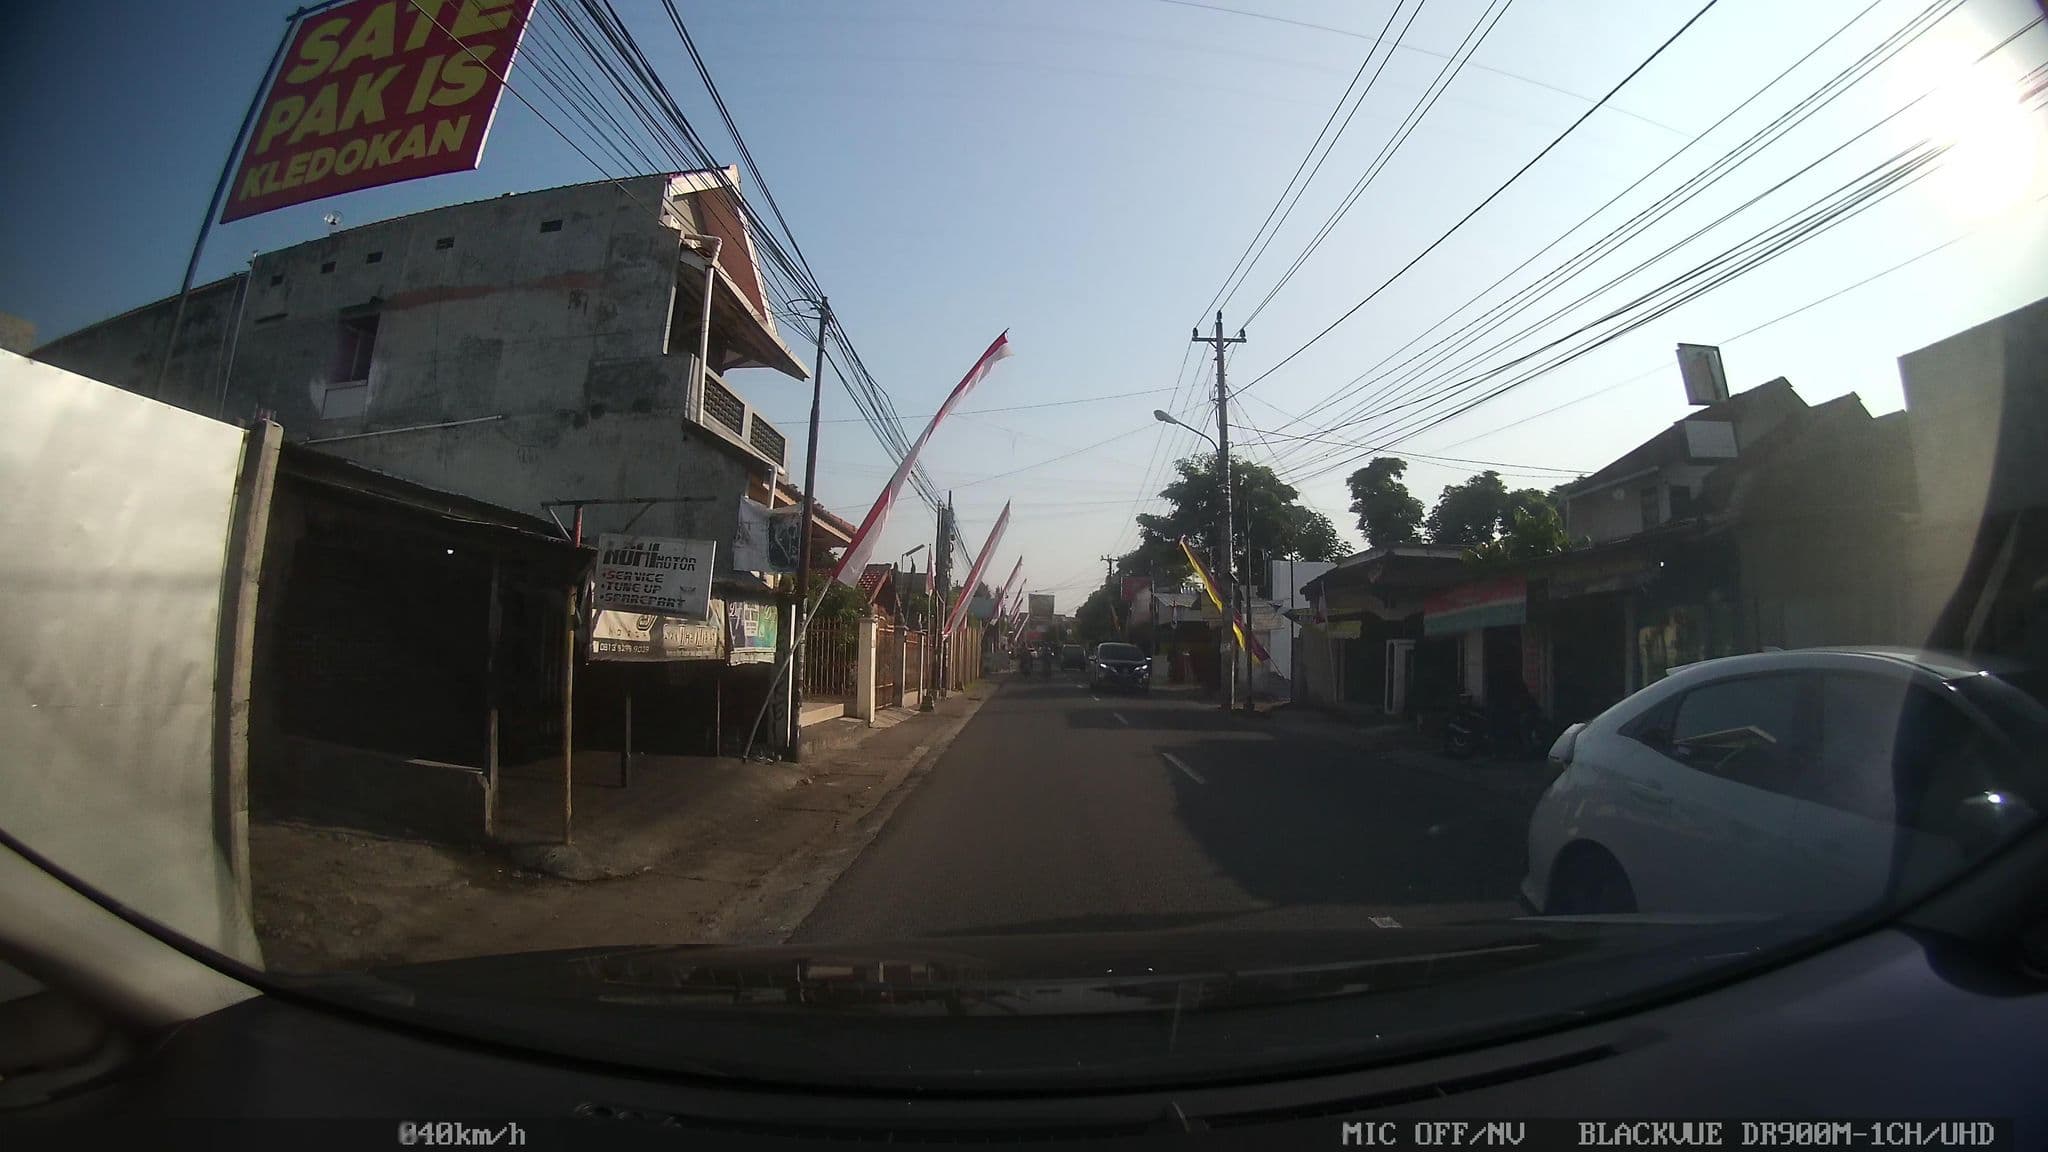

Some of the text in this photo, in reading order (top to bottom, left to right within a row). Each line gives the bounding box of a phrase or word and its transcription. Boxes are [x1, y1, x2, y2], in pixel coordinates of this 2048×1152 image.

[286, 0, 514, 84] SATE
[255, 44, 497, 155] PAK IS
[239, 115, 471, 201] KLEDOKAN
[656, 556, 697, 571] MOTOR
[606, 570, 664, 583] SERVICE
[606, 582, 662, 594] TUNE UP
[604, 593, 686, 608] SPAREPART
